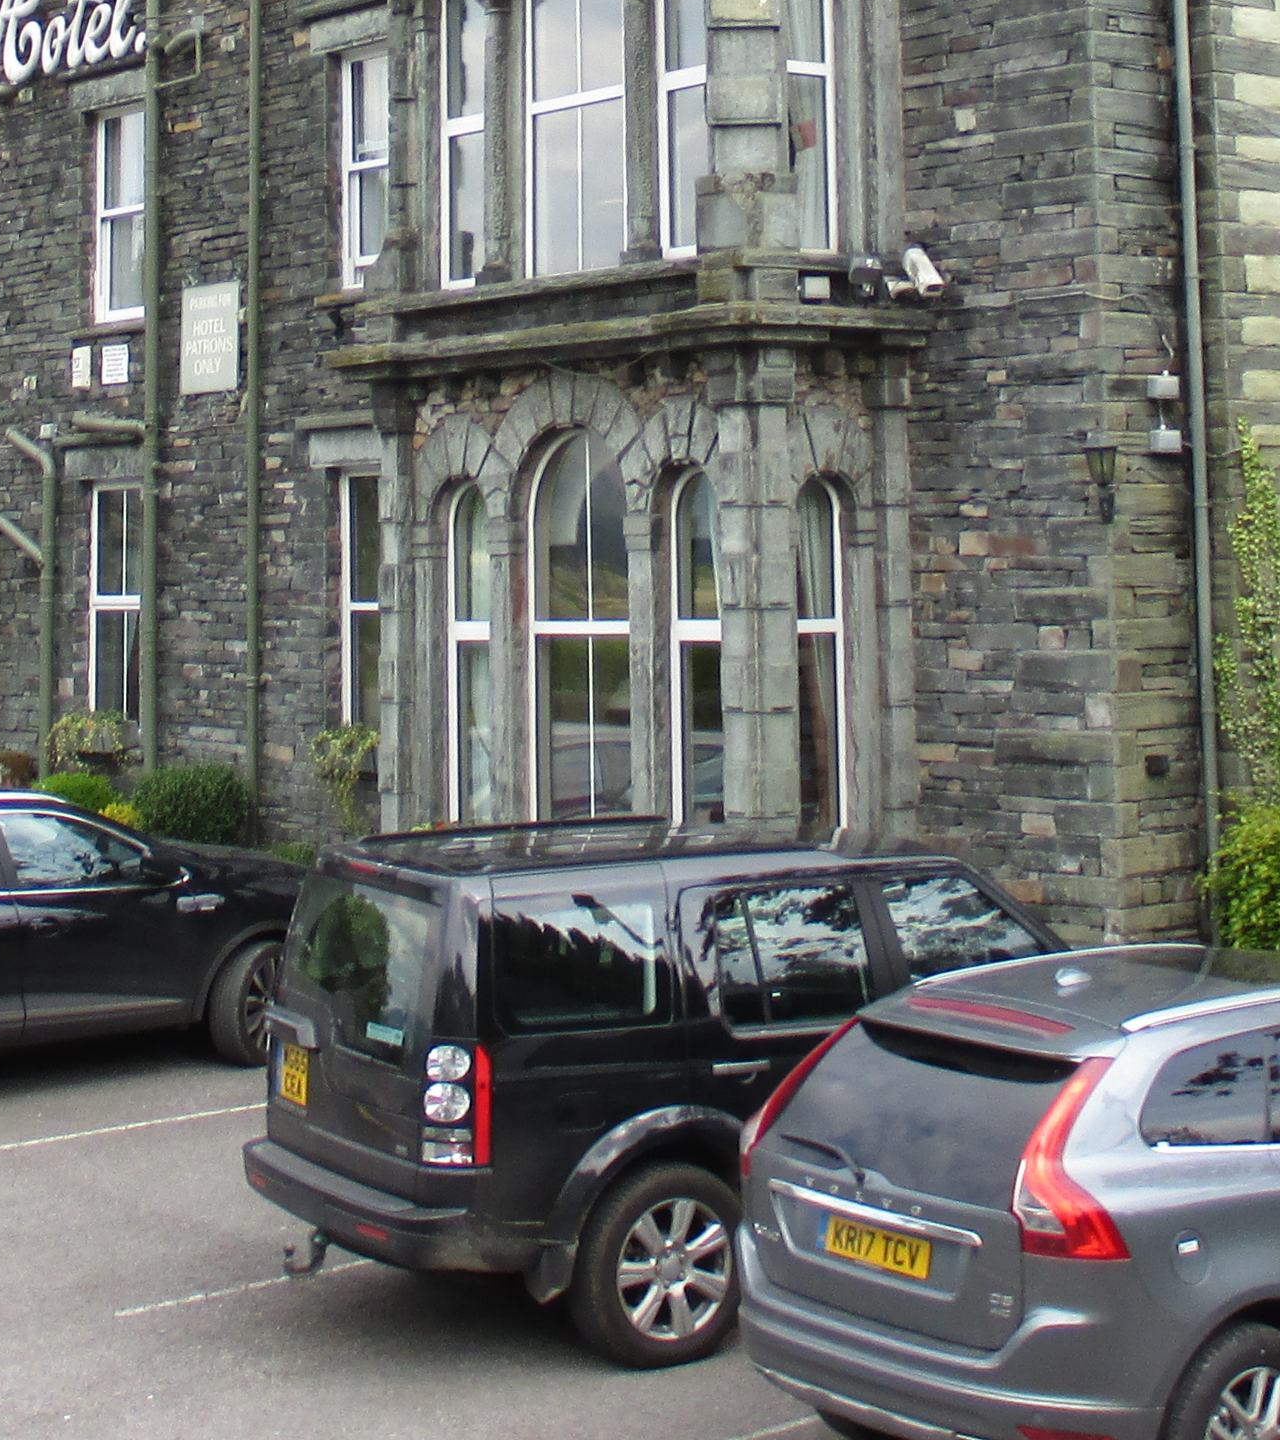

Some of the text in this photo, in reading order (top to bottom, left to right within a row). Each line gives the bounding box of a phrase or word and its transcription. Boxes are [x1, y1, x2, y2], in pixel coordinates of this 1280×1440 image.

[192, 317, 226, 336] HOTEL
[185, 336, 233, 356] PATRONS
[194, 357, 221, 375] ONLY
[833, 1220, 920, 1270] KR17 TCV
